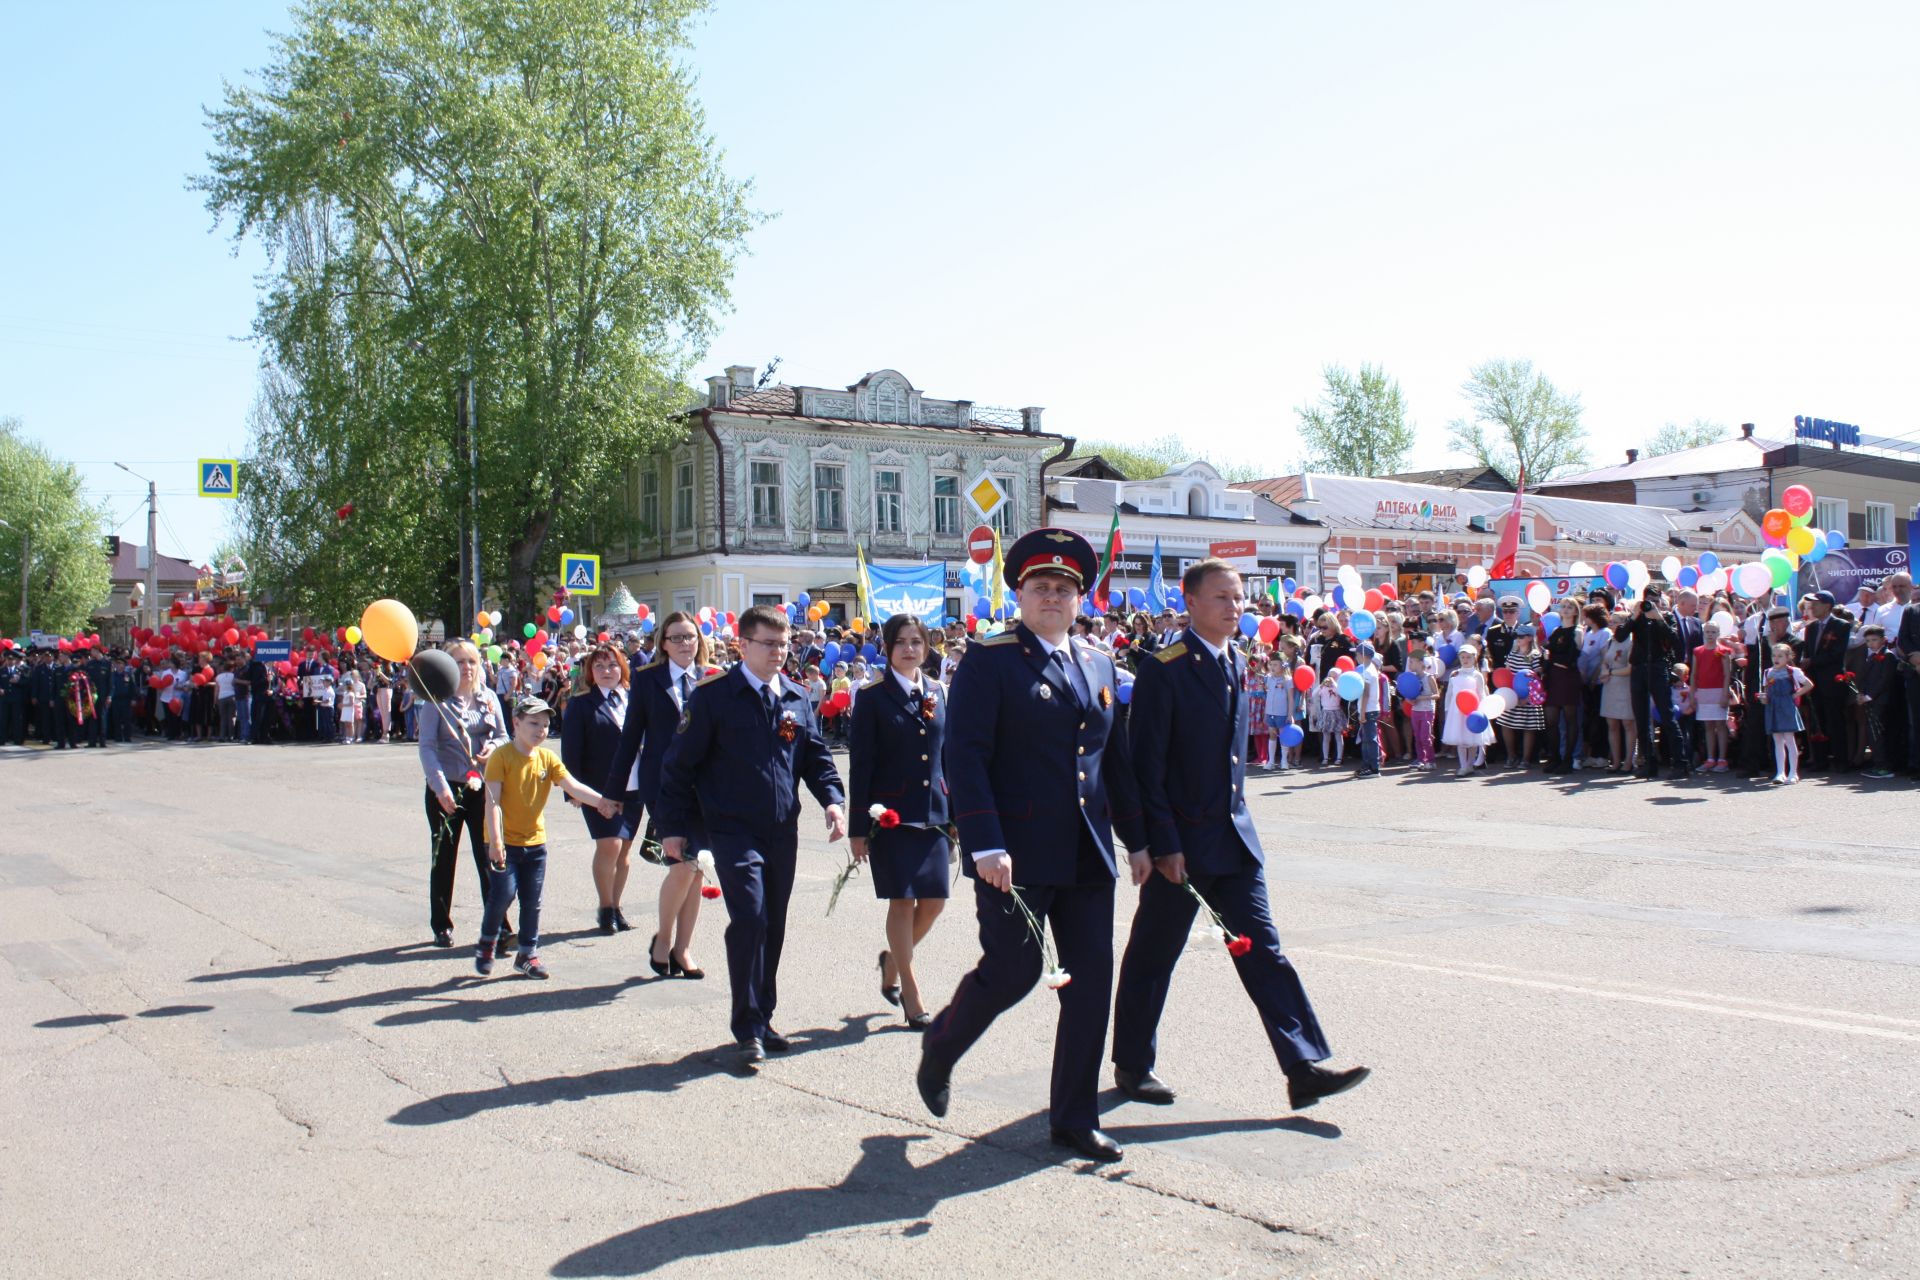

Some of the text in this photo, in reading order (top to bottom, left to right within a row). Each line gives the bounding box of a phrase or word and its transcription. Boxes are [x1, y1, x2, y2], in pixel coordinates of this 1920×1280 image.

[1794, 415, 1860, 446] SAMSUNG
[1376, 501, 1457, 517] АПТЕКА ВИТА
[1114, 561, 1142, 570] RAOKE
[1272, 567, 1286, 575] BAR
[1827, 566, 1908, 577] ЧИСТОПОЛЬСКИЙ
[1556, 580, 1570, 595] 9
